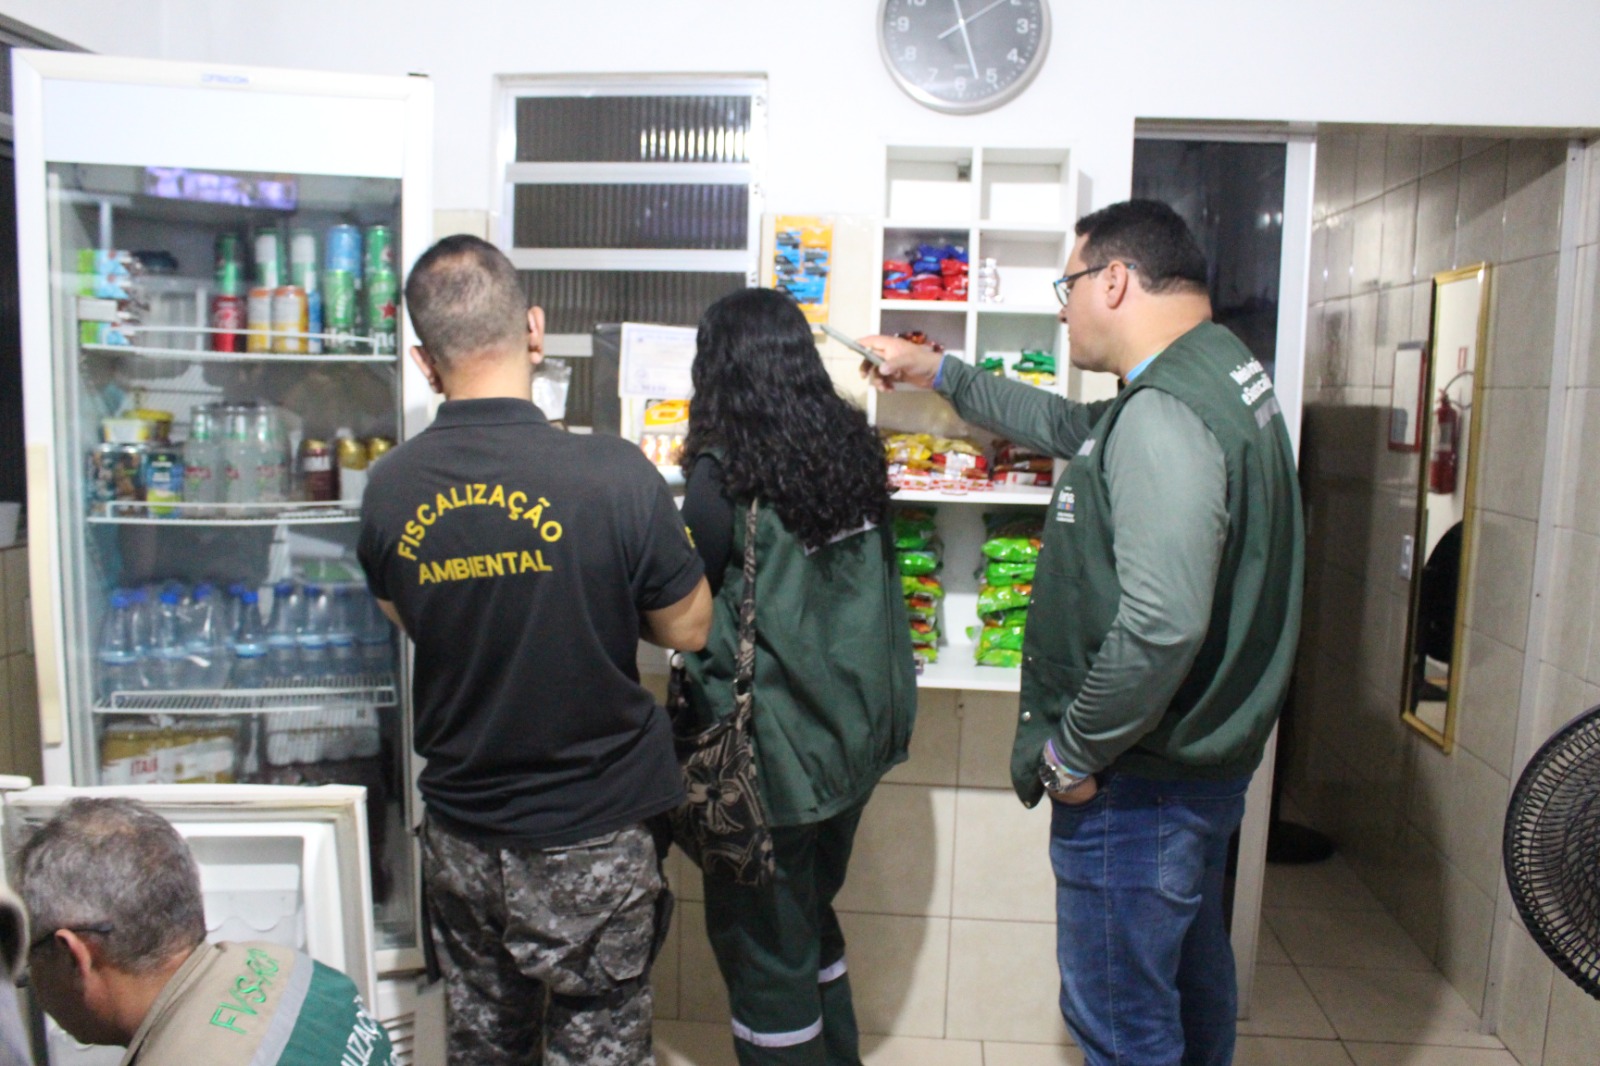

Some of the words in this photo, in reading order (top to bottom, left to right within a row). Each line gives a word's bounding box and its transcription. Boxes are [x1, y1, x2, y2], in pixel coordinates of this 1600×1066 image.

[896, 15, 910, 32] 9
[1016, 17, 1029, 34] 3
[904, 45, 917, 61] 8
[1006, 47, 1019, 63] 4
[985, 67, 998, 84] 5
[954, 76, 967, 93] 6
[397, 483, 563, 561] FISCALIZAÇÃO
[418, 549, 553, 585] AMBIENTAL
